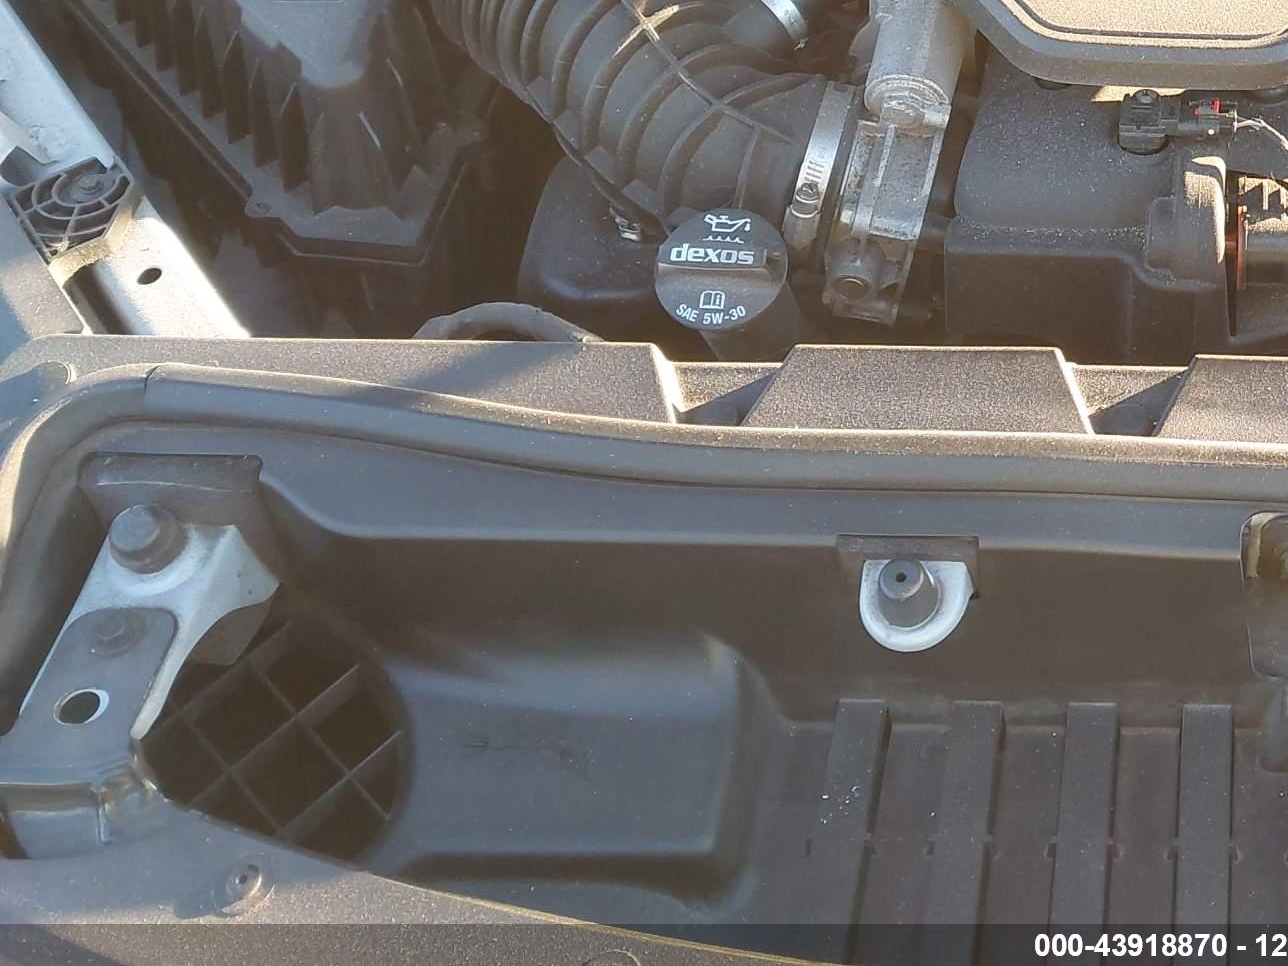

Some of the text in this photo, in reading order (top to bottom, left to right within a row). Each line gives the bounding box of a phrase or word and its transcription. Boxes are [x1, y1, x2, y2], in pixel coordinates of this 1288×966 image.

[670, 243, 755, 265] dexos
[675, 303, 747, 325] SAE 5W-30
